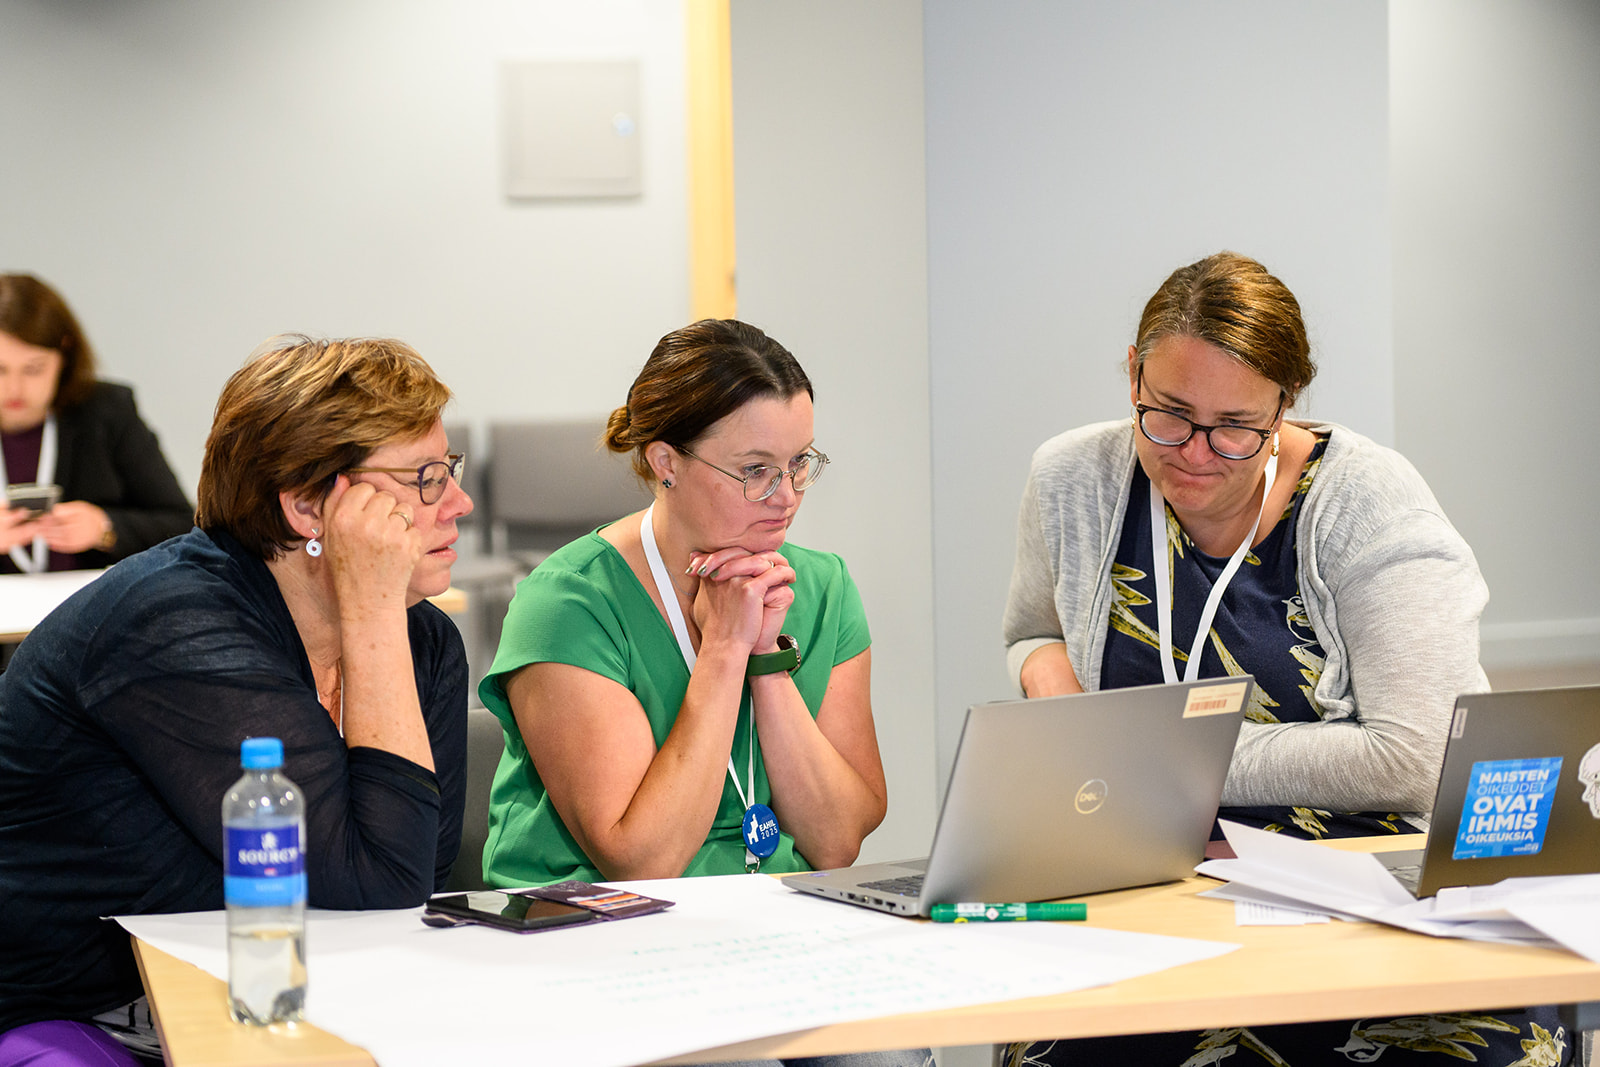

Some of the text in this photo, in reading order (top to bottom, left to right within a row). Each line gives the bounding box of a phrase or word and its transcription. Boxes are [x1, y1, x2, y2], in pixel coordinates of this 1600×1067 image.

[1478, 768, 1550, 785] NAISTEN
[1476, 781, 1546, 796] OIKEUDET
[1472, 793, 1545, 815] OVAT
[1467, 812, 1539, 833] IHMIS
[760, 826, 779, 840] 2025
